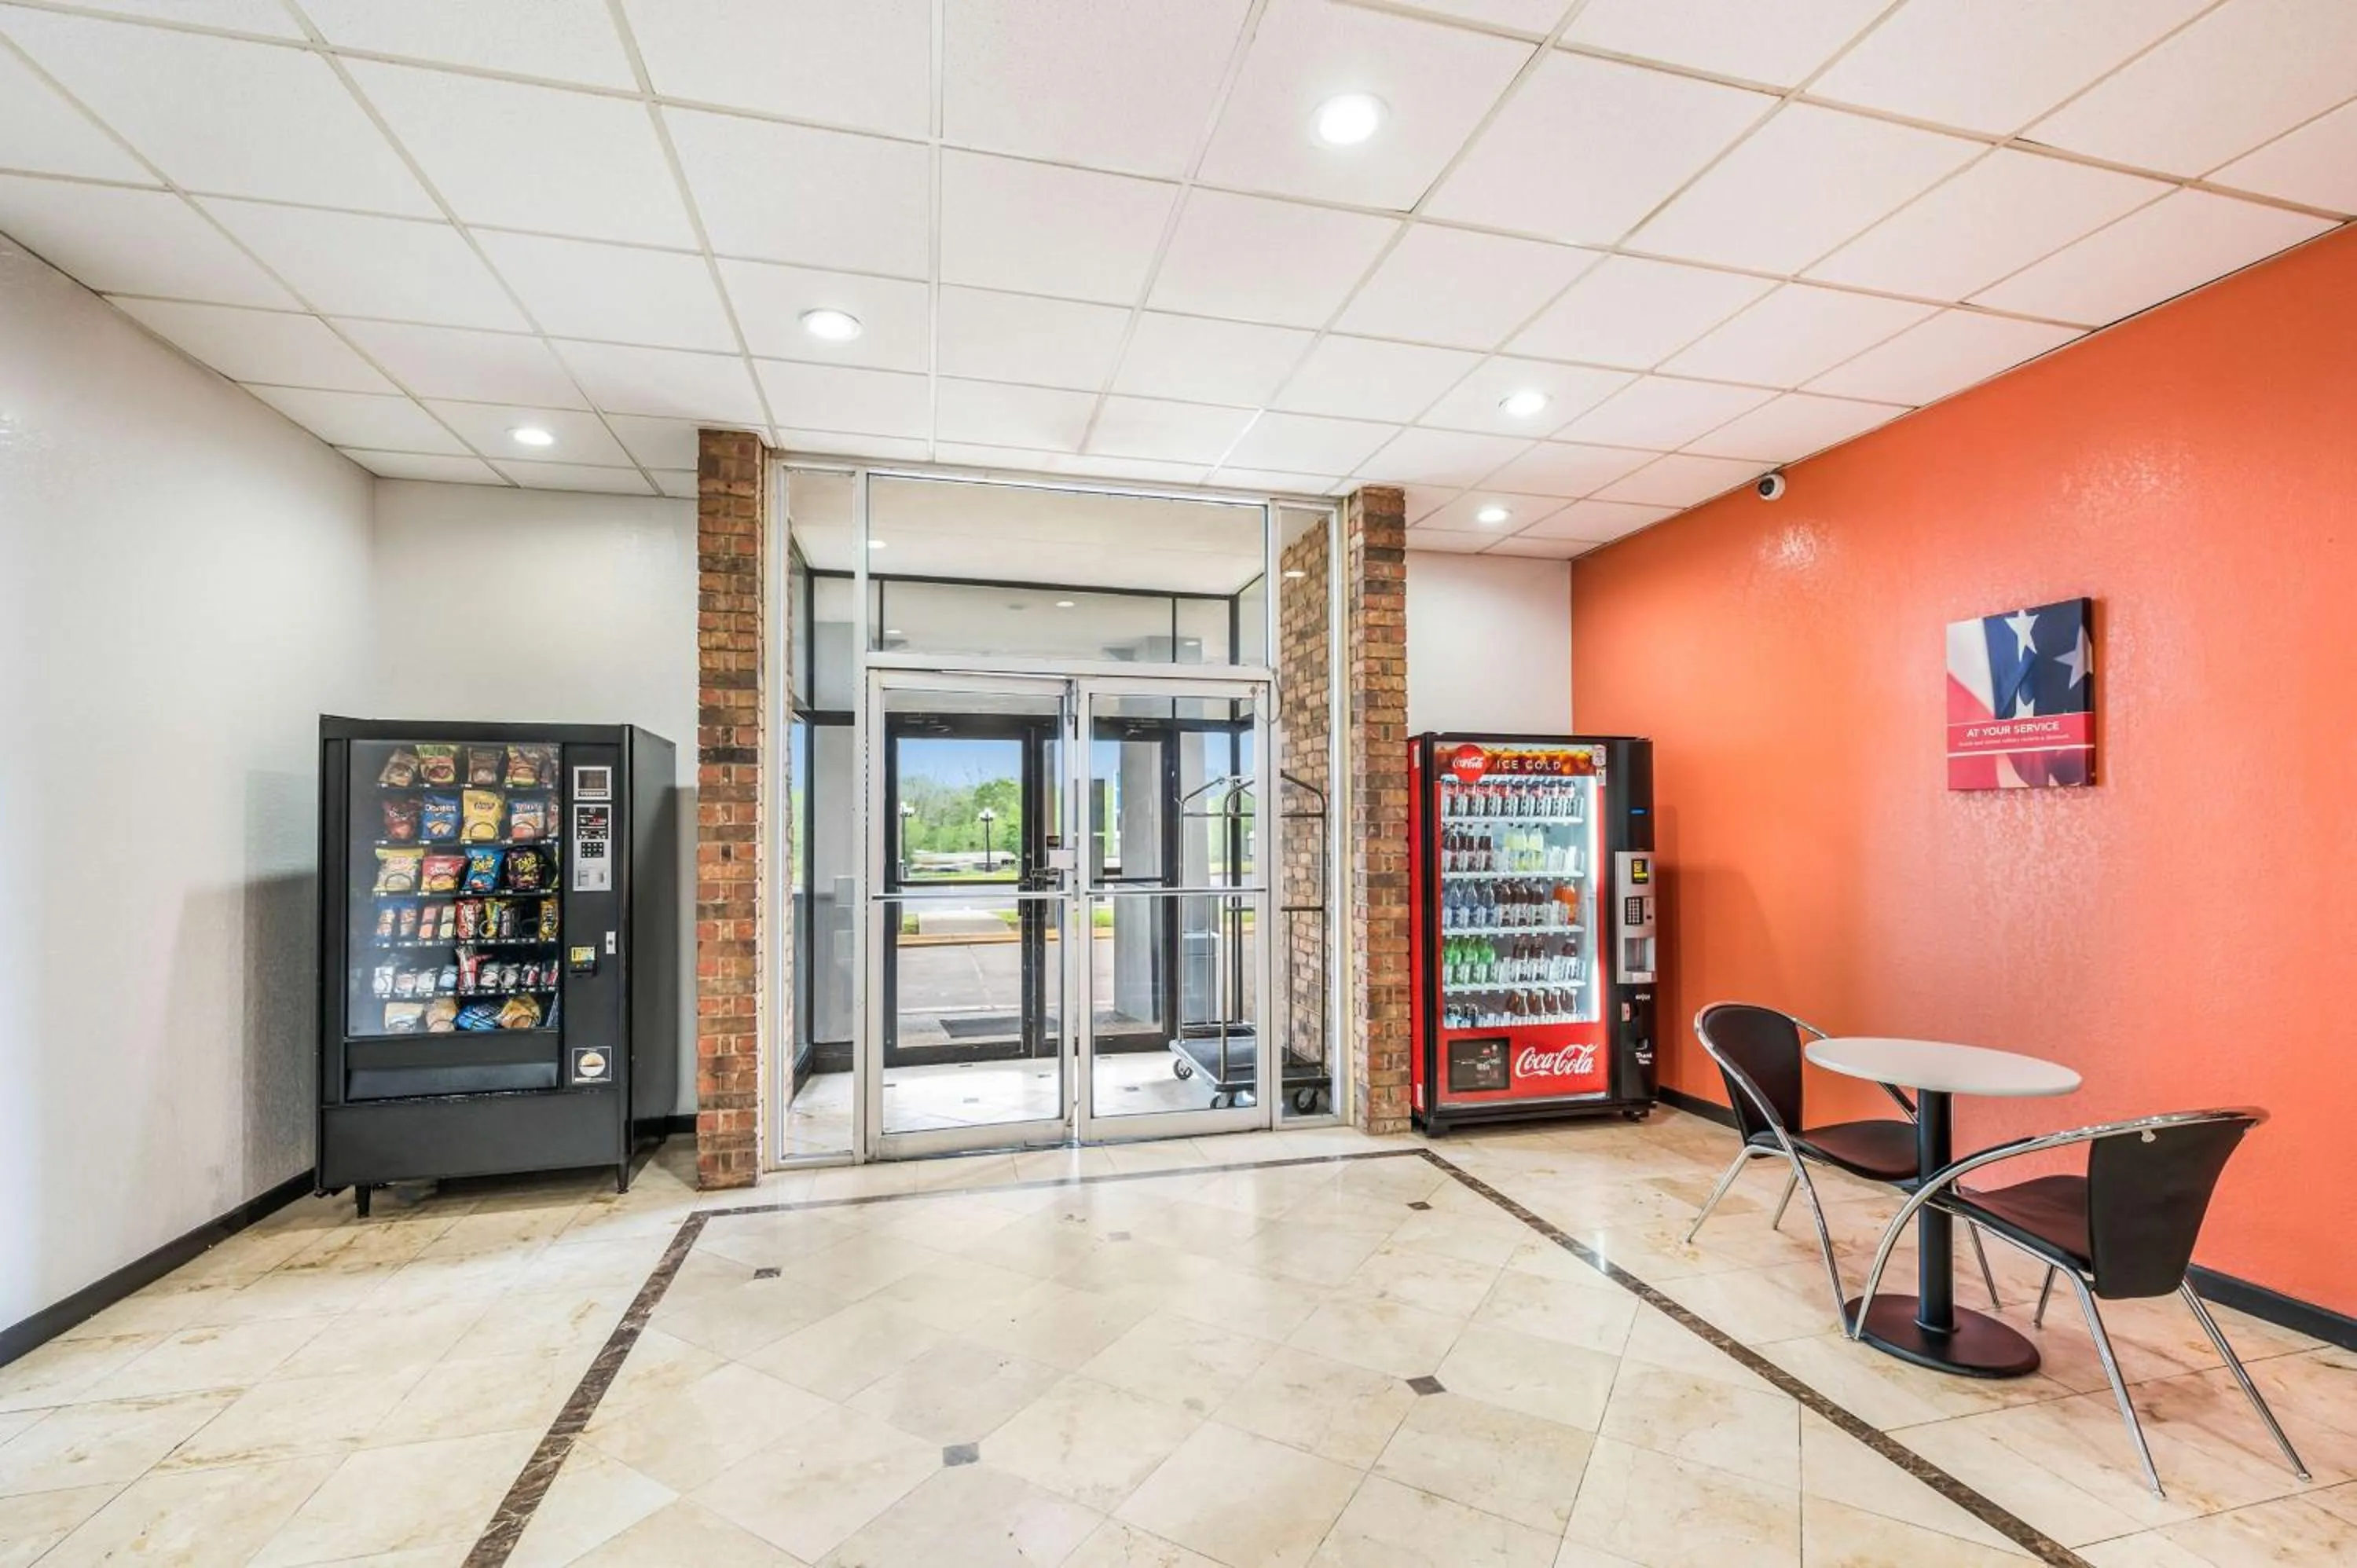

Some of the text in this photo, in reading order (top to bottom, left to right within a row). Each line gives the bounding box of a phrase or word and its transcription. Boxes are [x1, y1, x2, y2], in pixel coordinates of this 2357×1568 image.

[1966, 721, 2060, 738] AT YOUR SERVICE
[1496, 760, 1563, 771] ICE COLD
[1515, 1043, 1598, 1079] Coca-Cola
